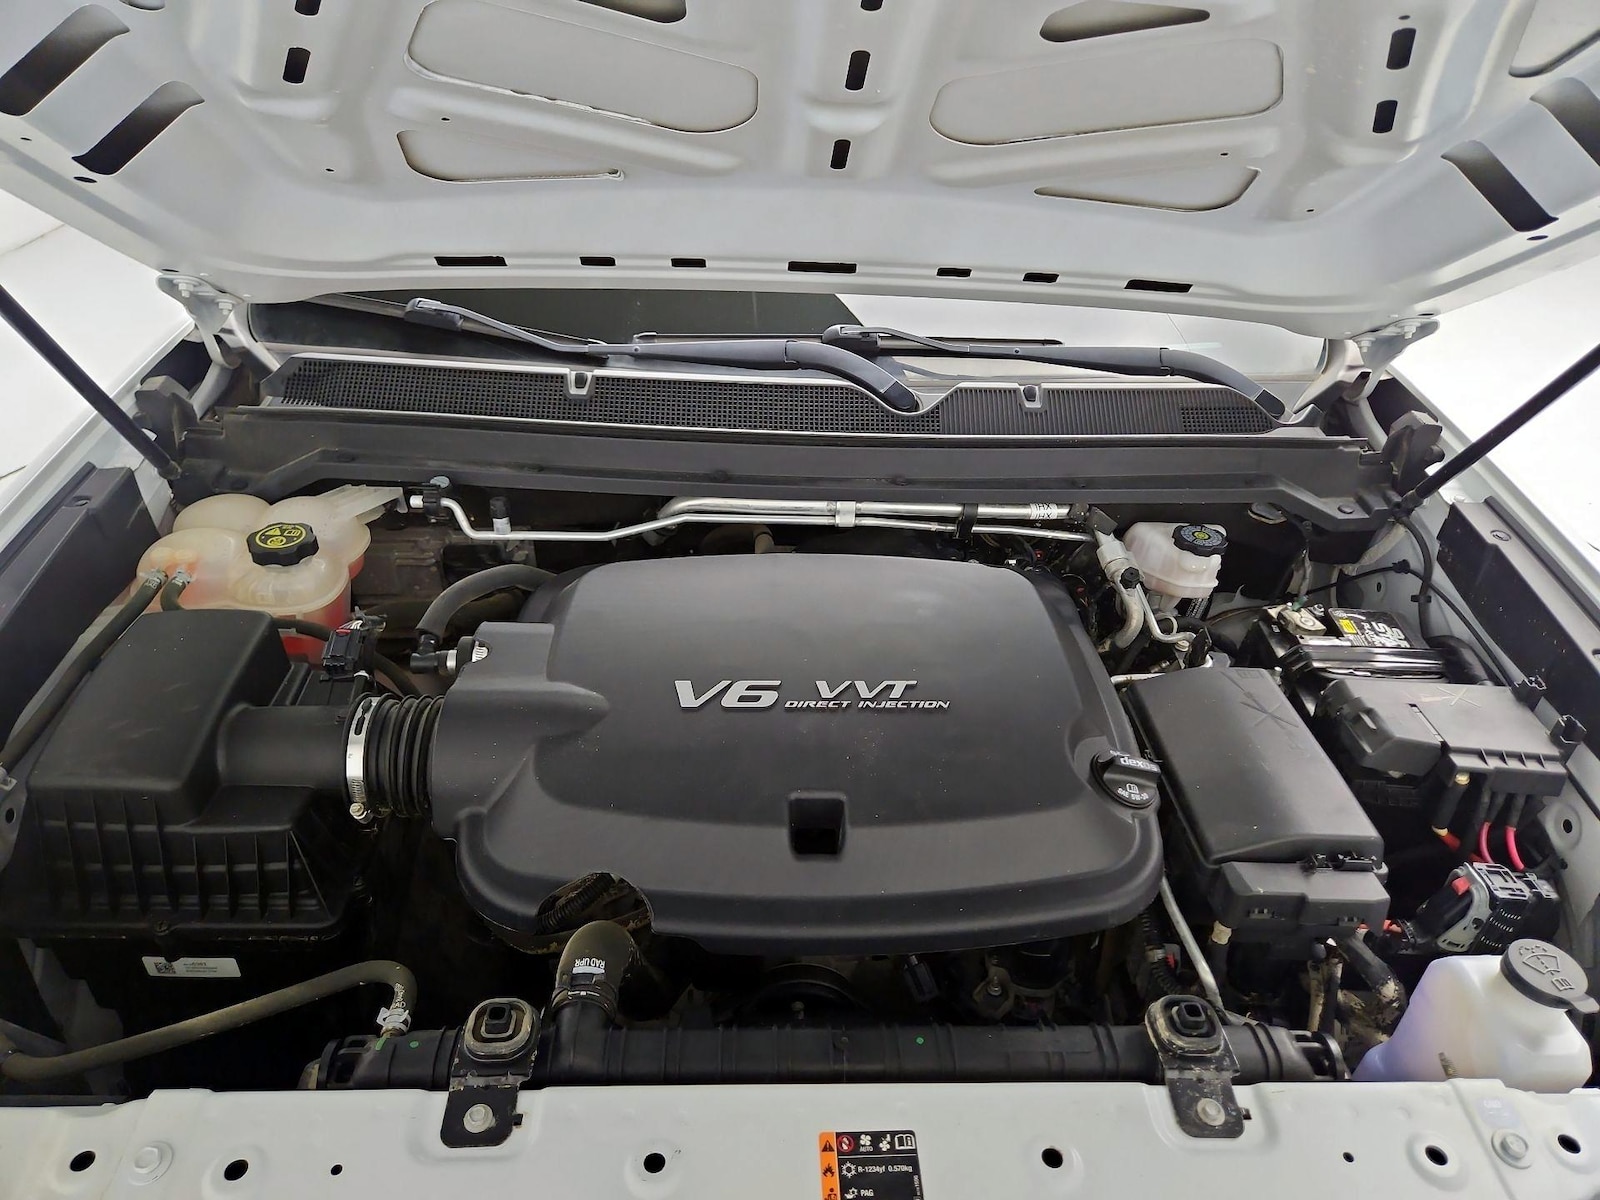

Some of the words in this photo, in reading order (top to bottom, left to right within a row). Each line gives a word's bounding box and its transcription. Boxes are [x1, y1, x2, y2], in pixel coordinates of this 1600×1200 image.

[674, 680, 782, 708] V6
[815, 680, 918, 699] VVT
[784, 700, 852, 709] DIRECT
[857, 700, 951, 709] INJECTION
[574, 957, 590, 968] UPR
[590, 957, 606, 969] RAD
[857, 1163, 886, 1175] R-1234yf
[887, 1161, 913, 1173] 0.570kg
[860, 1188, 874, 1197] PAG
